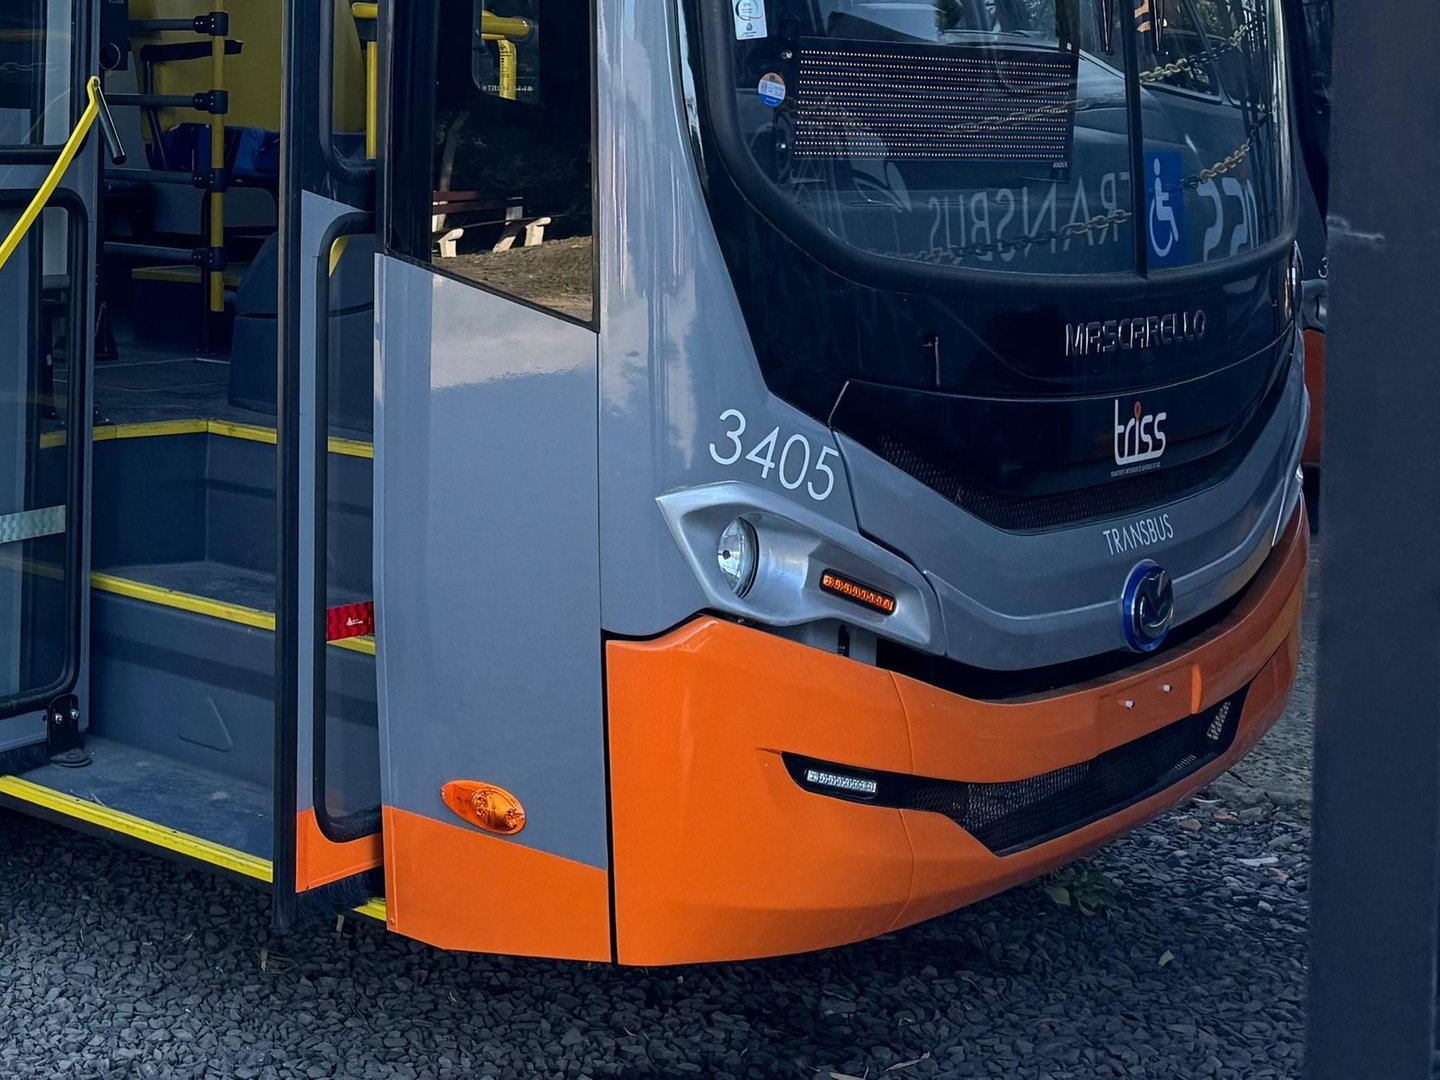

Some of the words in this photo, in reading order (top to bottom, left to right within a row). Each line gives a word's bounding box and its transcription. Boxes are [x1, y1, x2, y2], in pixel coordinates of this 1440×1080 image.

[1065, 309, 1207, 357] MASCARELLO
[709, 408, 840, 502] 3405
[1114, 398, 1167, 466] triss
[1103, 513, 1174, 556] TRANSBUS
